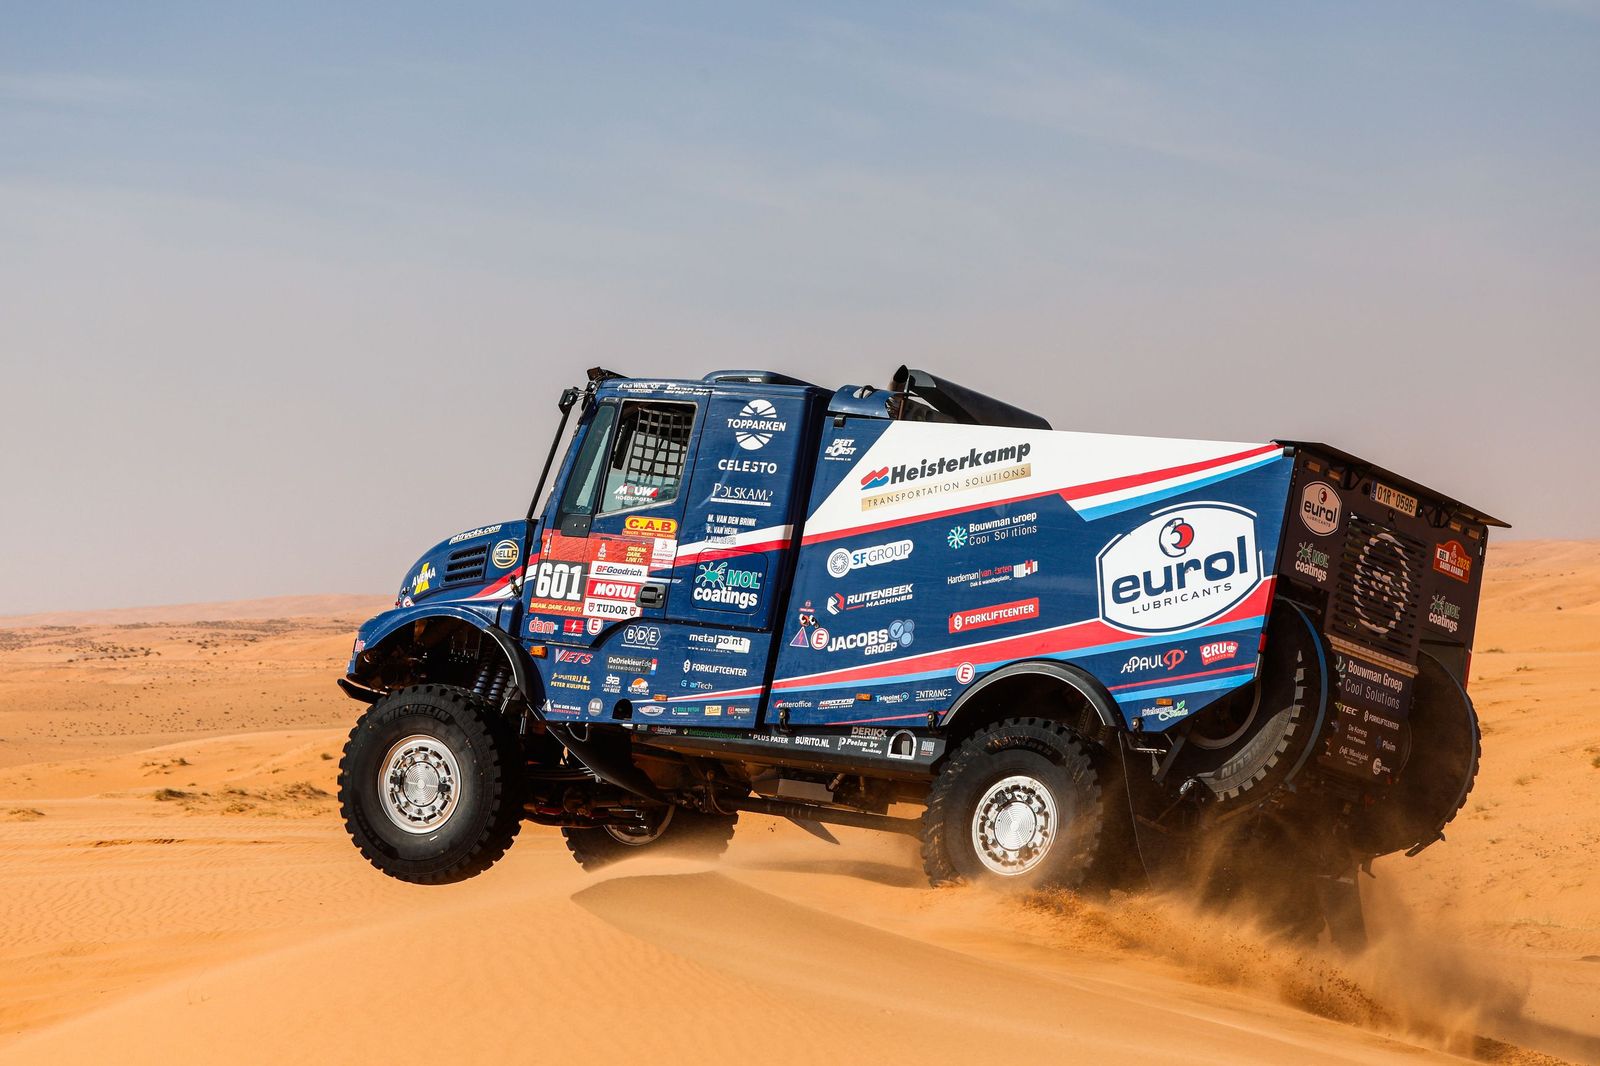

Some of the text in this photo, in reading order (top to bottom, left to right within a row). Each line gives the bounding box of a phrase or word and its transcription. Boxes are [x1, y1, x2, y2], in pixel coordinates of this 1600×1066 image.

[727, 418, 786, 432] TOPPARKEN
[825, 445, 857, 457] BORST
[832, 438, 855, 447] PEET
[718, 459, 778, 474] CELESTO
[890, 442, 1031, 485] Heisterkamp
[867, 466, 1026, 508] TRANSPORTATION SOLUTIONS
[1303, 499, 1337, 524] eurol
[1395, 493, 1414, 513] 0596
[629, 518, 672, 531] C.A.B
[707, 514, 714, 522] M.
[716, 515, 727, 523] VAN
[728, 516, 739, 525] DEN
[969, 512, 1037, 533] Bouwman Groep
[495, 549, 518, 558] HELLA
[596, 565, 643, 577] BFGoodrich
[947, 569, 979, 585] Hardeman
[980, 570, 992, 578] van
[1112, 536, 1248, 605] eurol
[1295, 560, 1327, 582] coatings
[535, 562, 582, 601] 601
[593, 582, 637, 599] MOTUL
[693, 586, 758, 609] coatings
[846, 583, 914, 605] RUITENBEEK
[1132, 583, 1232, 614] LUBRICANTS
[596, 603, 628, 615] TUDOR
[865, 594, 913, 608] MACHINES
[965, 604, 1035, 625] FORKLIFTCENTER
[1428, 612, 1458, 633] coatings
[529, 617, 556, 635] dam
[591, 619, 599, 630] E
[816, 633, 825, 645] E
[827, 629, 889, 652] JACOBS
[864, 642, 898, 655] GROEP
[692, 663, 747, 677] FORKLIFTCENTER
[961, 667, 970, 680] E
[1348, 660, 1403, 693] Bouwman Groep
[681, 680, 713, 690] GarTech
[1345, 679, 1400, 710] Cool Solutions
[382, 704, 450, 724] MICHELIN
[1368, 714, 1400, 731] FORKLIFTCENTER
[753, 734, 789, 744] PLUS PATER
[795, 736, 830, 748] BURITO.NL
